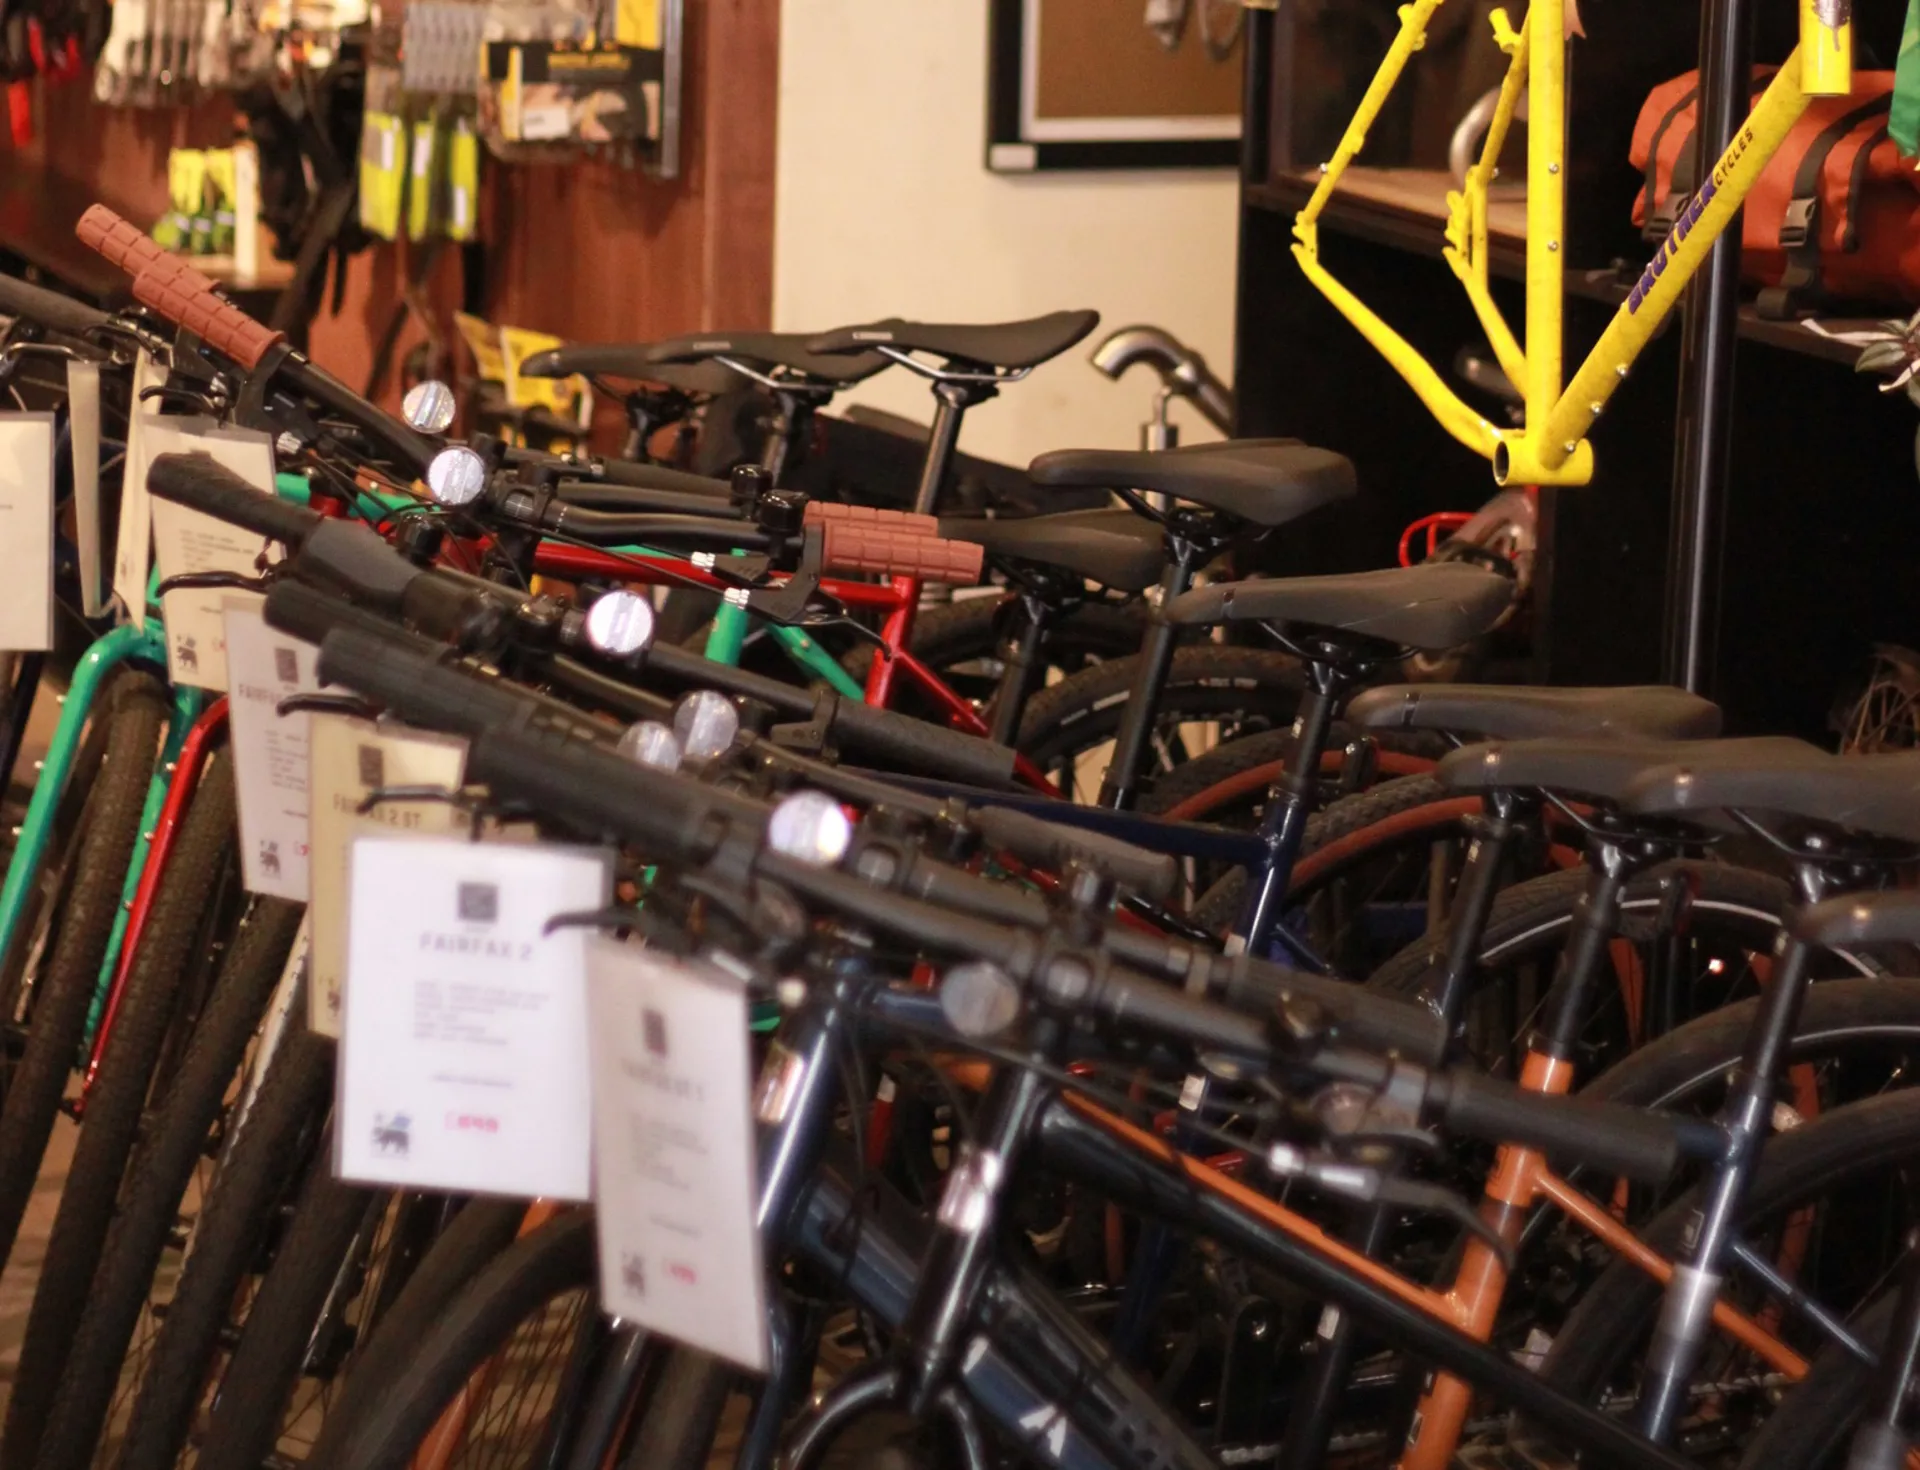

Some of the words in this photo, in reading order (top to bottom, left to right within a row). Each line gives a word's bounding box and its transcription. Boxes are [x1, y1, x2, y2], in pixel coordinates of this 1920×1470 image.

[1715, 128, 1755, 186] CYCLES
[419, 930, 512, 958] FAIRFAX
[520, 943, 533, 961] 2
